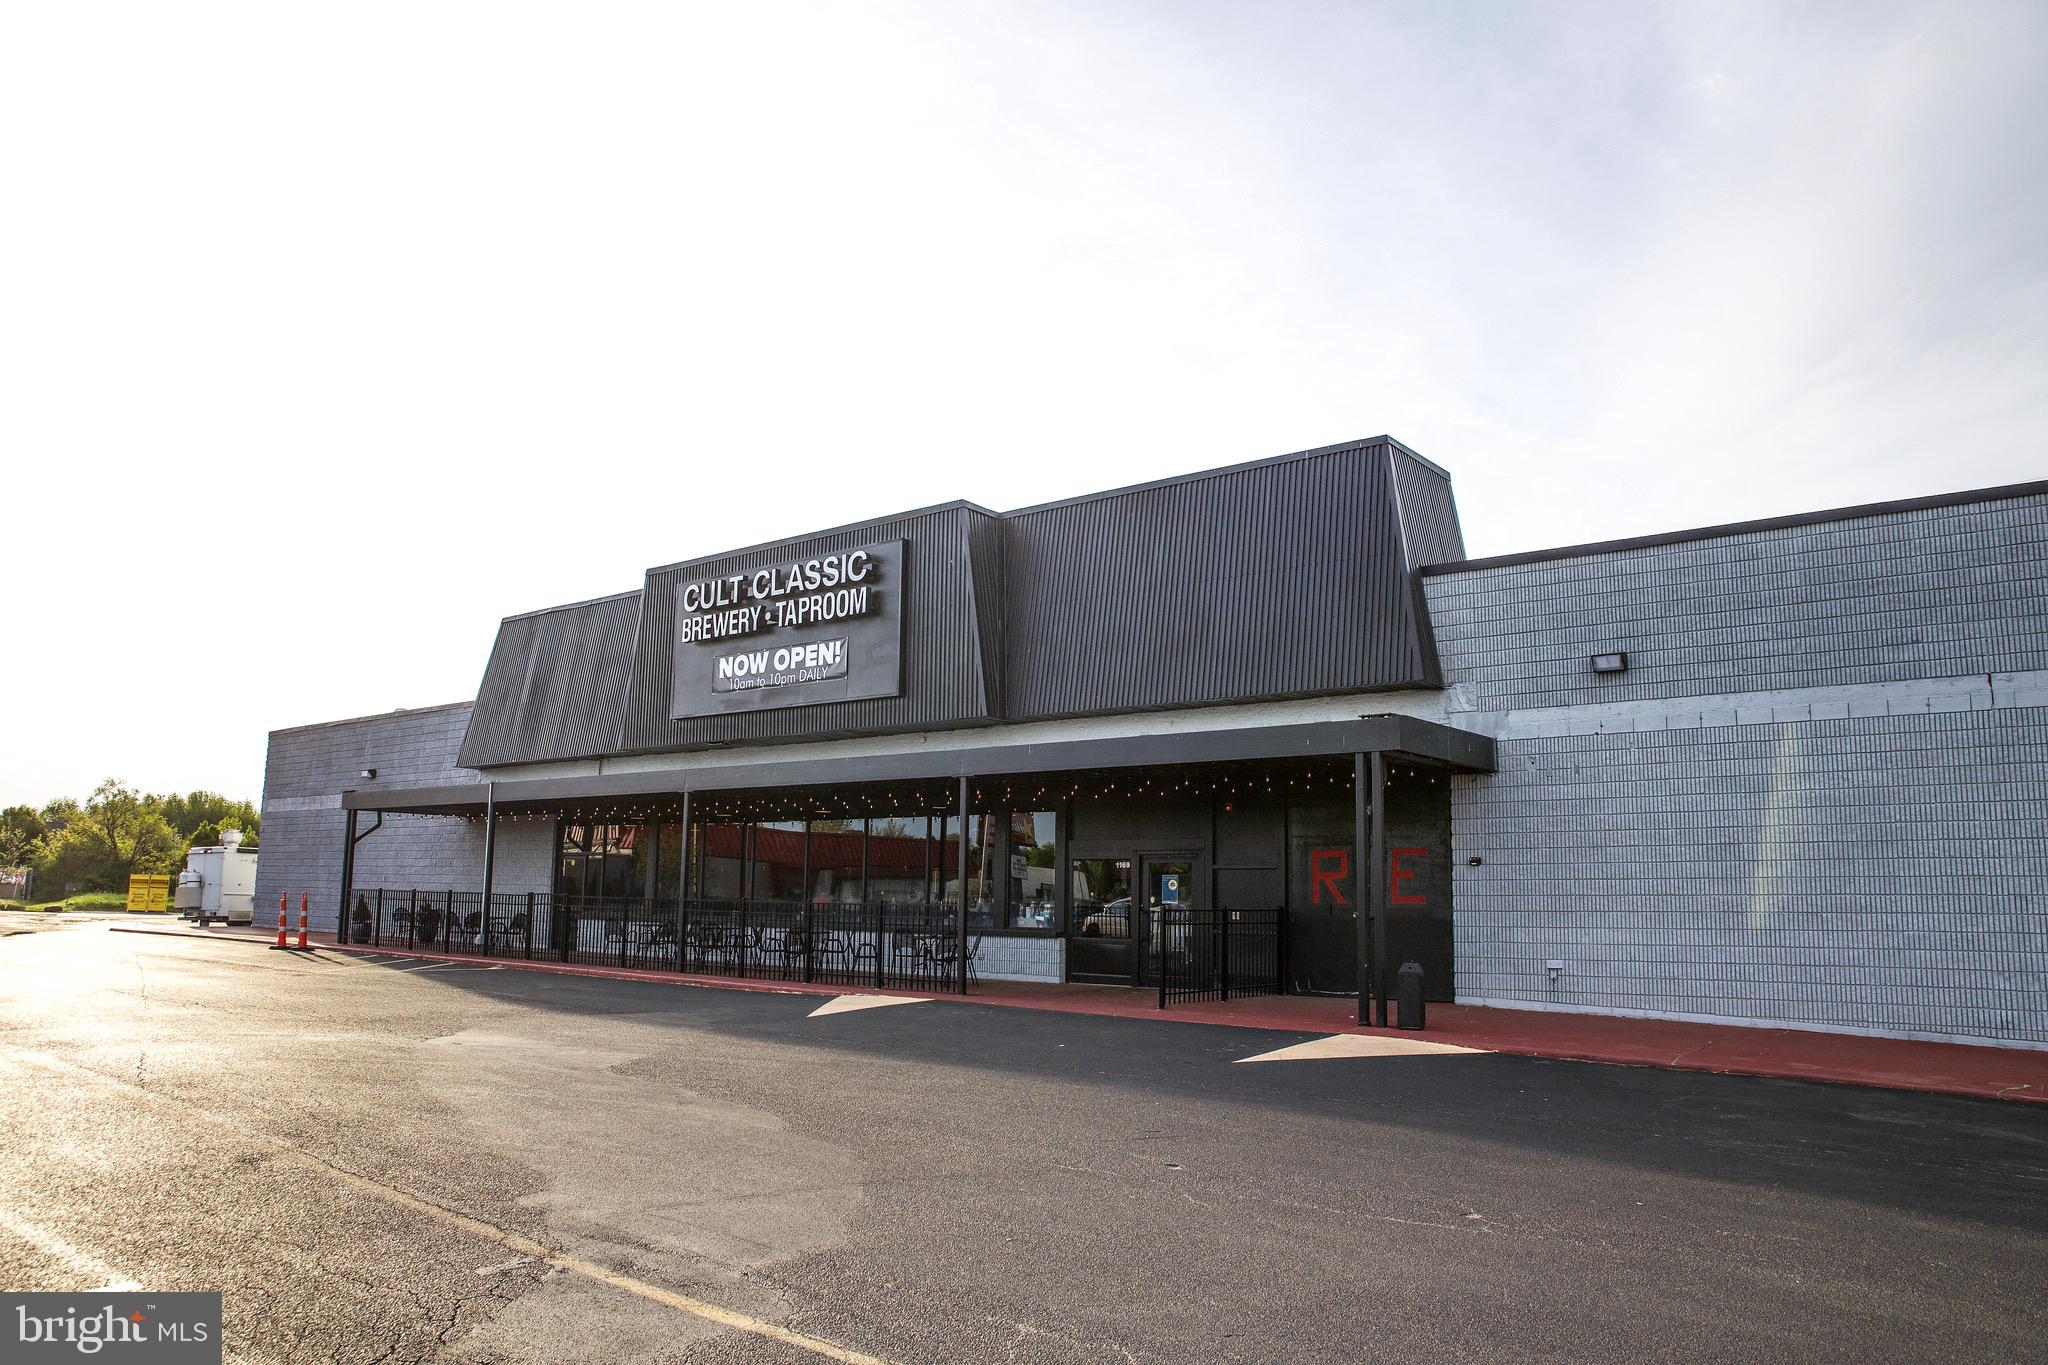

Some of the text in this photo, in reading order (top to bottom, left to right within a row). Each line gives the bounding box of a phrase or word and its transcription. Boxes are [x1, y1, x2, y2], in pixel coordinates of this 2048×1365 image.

[684, 551, 868, 612] CULT CLASSIC
[682, 586, 867, 643] BREWERY TAPROOM
[719, 640, 841, 678] NOW OPEN!
[729, 666, 829, 690] 10am to 10pm DAILY
[1116, 861, 1131, 869] 1169
